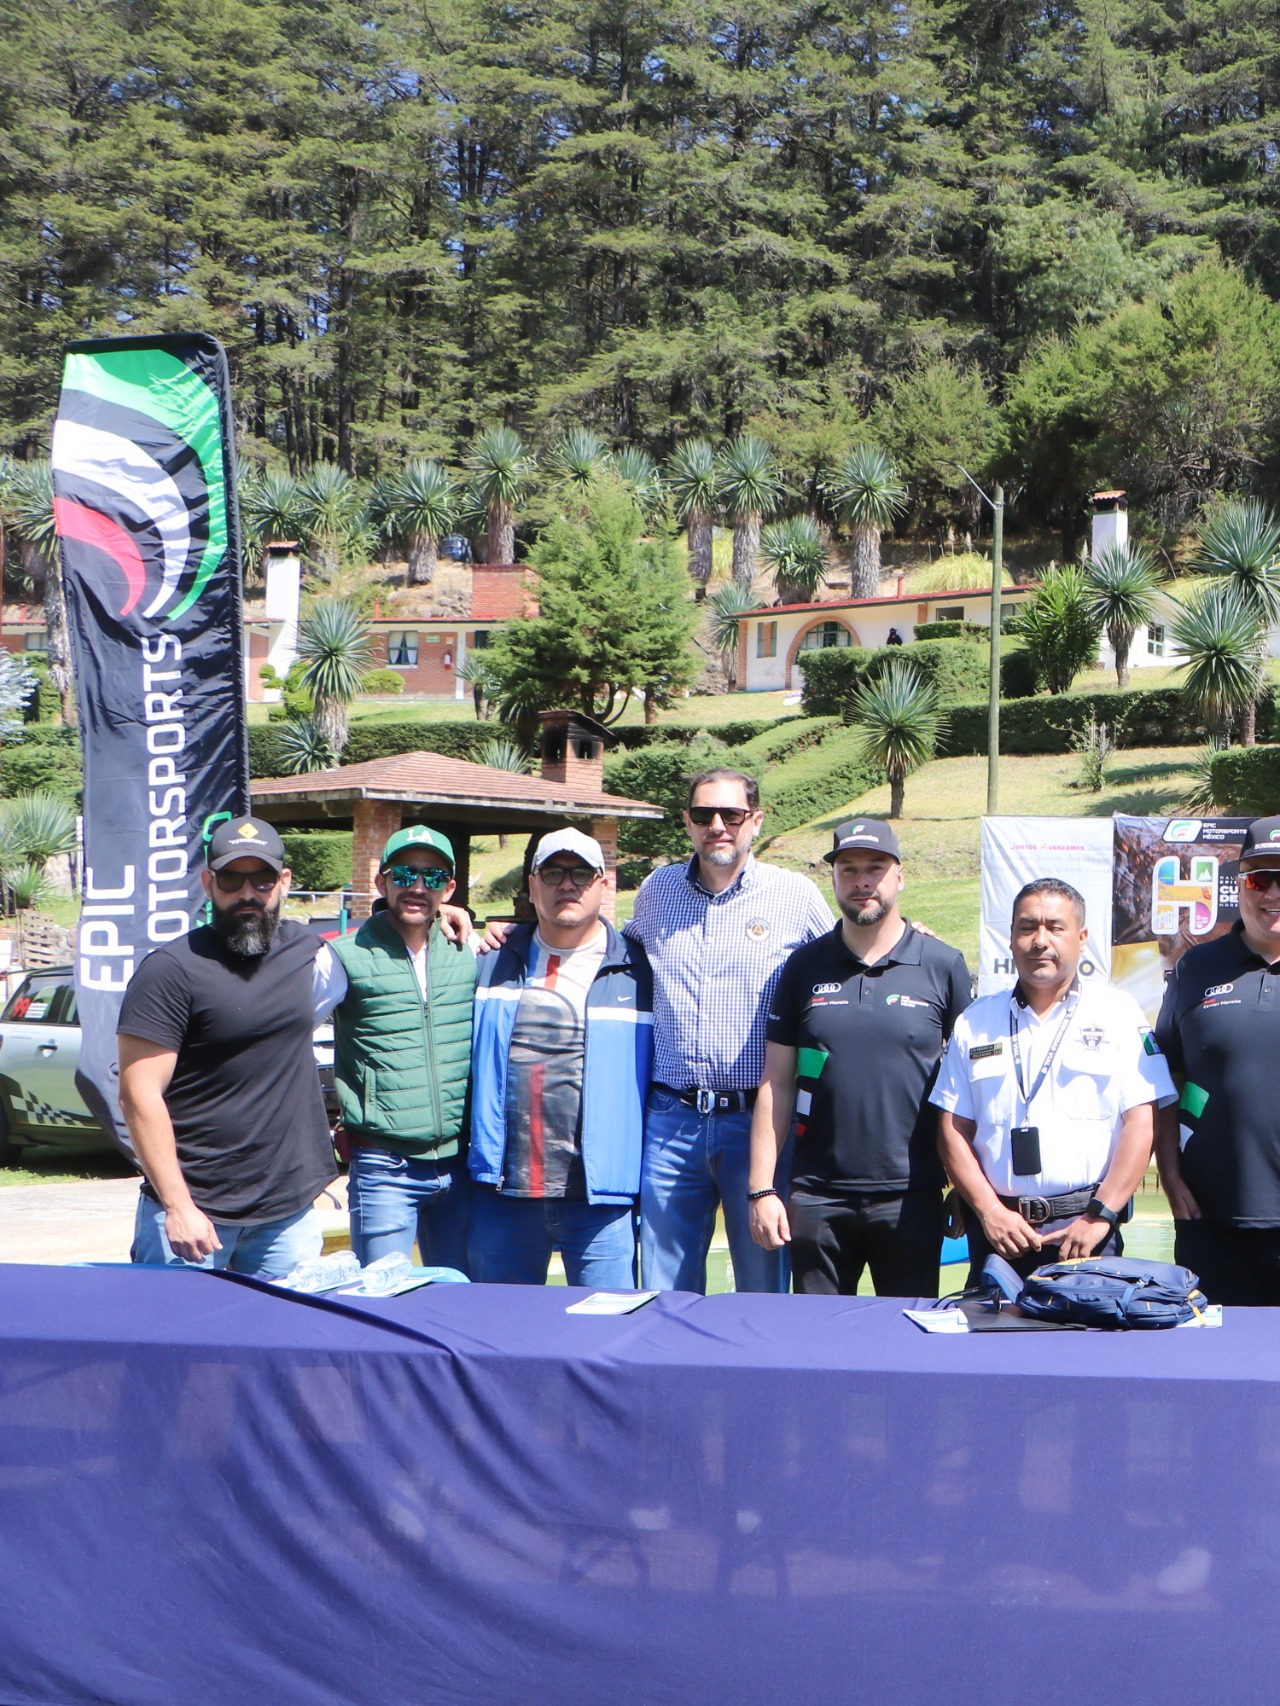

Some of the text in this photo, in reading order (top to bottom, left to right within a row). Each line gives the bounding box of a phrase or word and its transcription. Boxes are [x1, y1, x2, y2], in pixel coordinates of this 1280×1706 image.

[141, 632, 189, 953] OTORSPORTS
[406, 828, 435, 845] LA
[80, 864, 135, 992] EPIC
